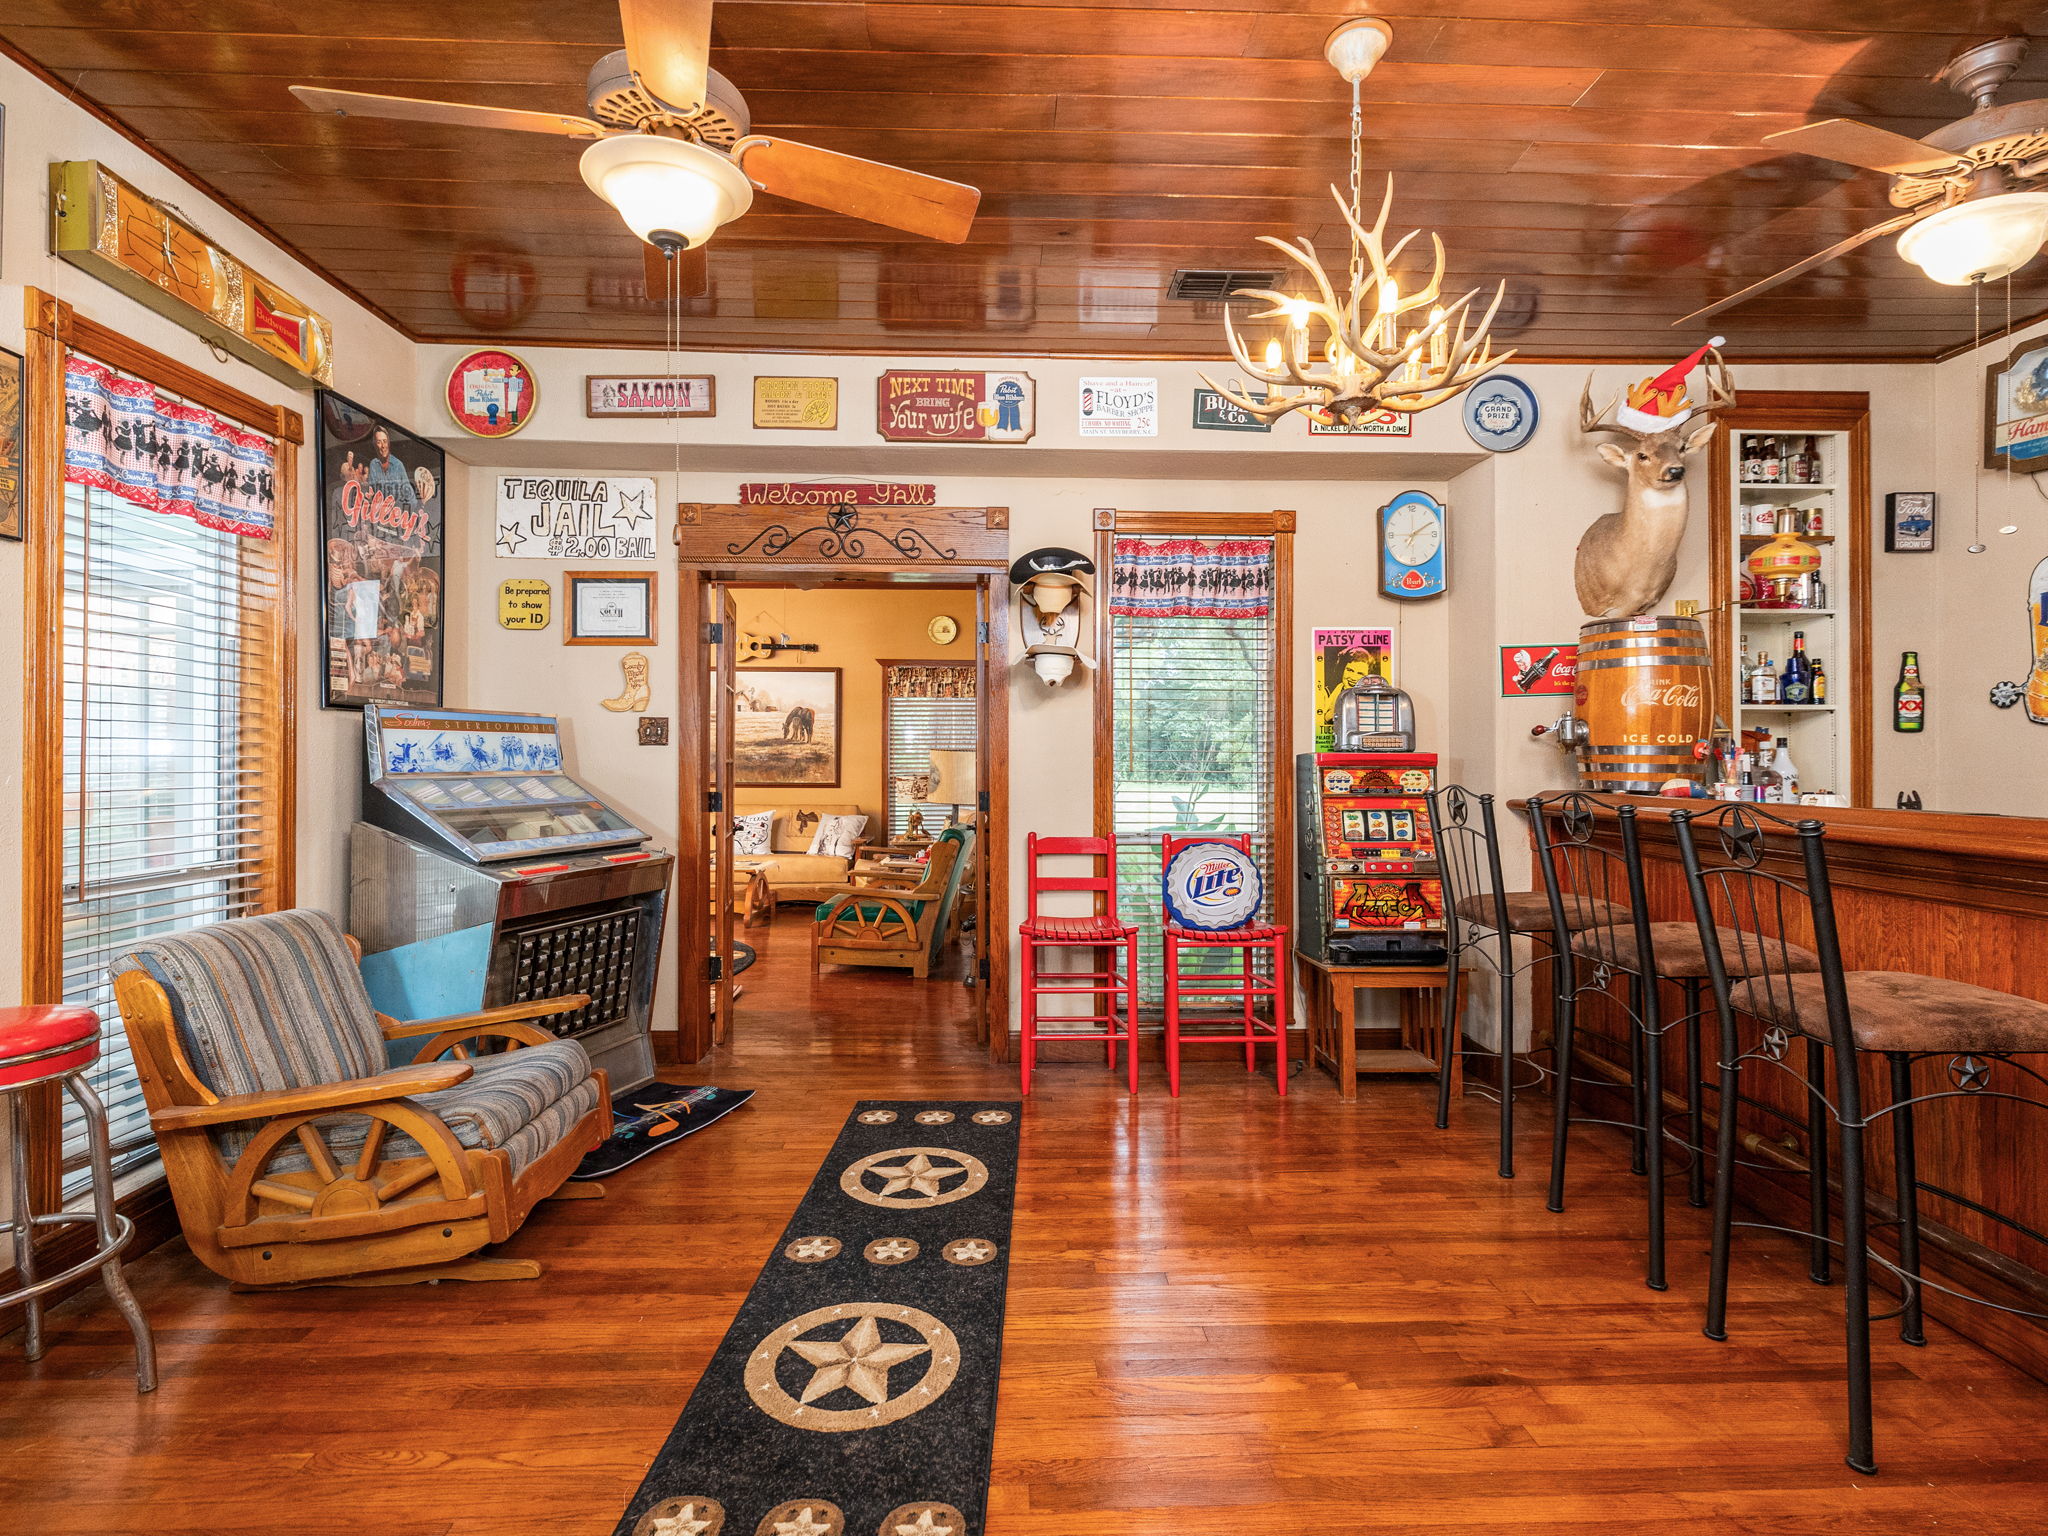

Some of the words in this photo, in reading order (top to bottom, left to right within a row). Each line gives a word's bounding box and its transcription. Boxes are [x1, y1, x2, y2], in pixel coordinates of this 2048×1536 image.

[256, 306, 299, 341] Budweiser
[617, 382, 692, 408] SALOON
[889, 377, 931, 399] NEXT
[937, 379, 975, 401] TIME
[1000, 384, 1018, 394] Pabst
[915, 397, 951, 408] BRING
[1096, 390, 1154, 409] FLOYD'S
[1096, 404, 1126, 418] BARBER
[1127, 404, 1154, 418] SHOPPE
[1219, 410, 1228, 420] &
[889, 400, 928, 429] Your
[927, 400, 975, 437] wife
[503, 478, 609, 503] TEQUILA
[747, 483, 858, 505] Welcome
[342, 480, 432, 542] Gilley's
[1897, 500, 1931, 514] Ford
[530, 502, 616, 539] JAIL
[614, 537, 656, 559] BAIL
[505, 586, 514, 595] Be
[515, 587, 550, 598] prepared
[508, 601, 518, 609] to
[521, 601, 542, 609] show
[505, 616, 526, 626] your
[530, 613, 544, 624] ID
[1318, 634, 1356, 646] PATSY
[1361, 635, 1389, 645] CLINE
[445, 720, 555, 733] STEREOPHONIC
[1623, 734, 1649, 743] ICE
[1656, 734, 1694, 744] COLD
[1200, 862, 1231, 875] Miller
[1192, 867, 1242, 900] Lite
